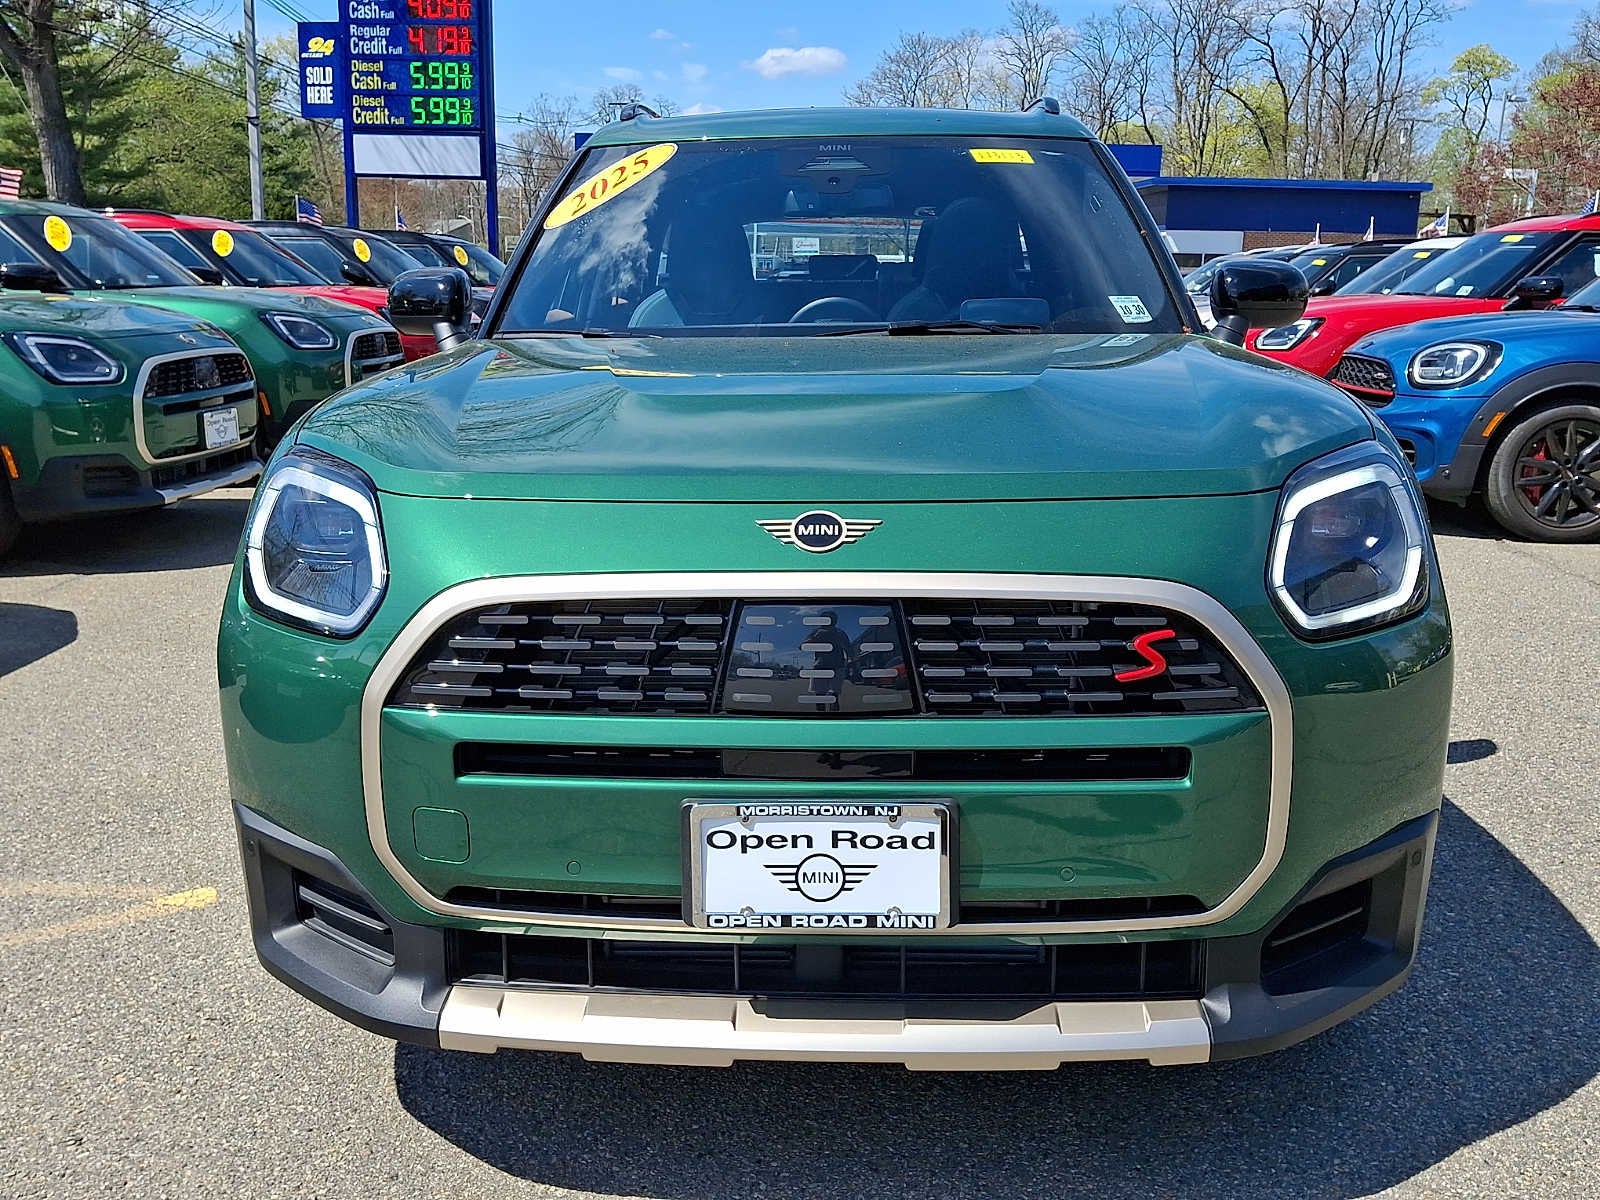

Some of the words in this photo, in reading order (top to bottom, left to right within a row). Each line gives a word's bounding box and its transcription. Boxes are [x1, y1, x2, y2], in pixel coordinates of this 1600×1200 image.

[349, 1, 379, 19] Cash
[380, 10, 395, 19] Full
[408, 0, 458, 19] 4.09
[349, 24, 391, 38] Regular
[307, 36, 335, 56] 94
[350, 36, 387, 55] Credit
[388, 46, 403, 55] Full
[408, 26, 459, 55] 4.19
[351, 60, 384, 72] Diesel
[305, 66, 333, 85] SOLD
[351, 72, 382, 90] Cash
[383, 81, 397, 90] Full
[409, 61, 459, 90] 5.99
[306, 86, 334, 104] HERE
[352, 95, 385, 107] Diesel
[352, 107, 389, 125] Credit
[390, 116, 405, 125] Full
[410, 96, 460, 125] 5.99
[571, 152, 649, 217] 2025
[798, 524, 839, 536] MINI
[1114, 629, 1176, 683] S
[739, 806, 868, 816] MORRISTOWN,
[874, 806, 899, 817] NJ
[706, 829, 814, 854] Open
[830, 829, 936, 850] Road
[802, 871, 840, 884] MINI
[708, 915, 782, 928] OPEN
[791, 915, 867, 928] ROAD
[876, 915, 934, 929] MINI
